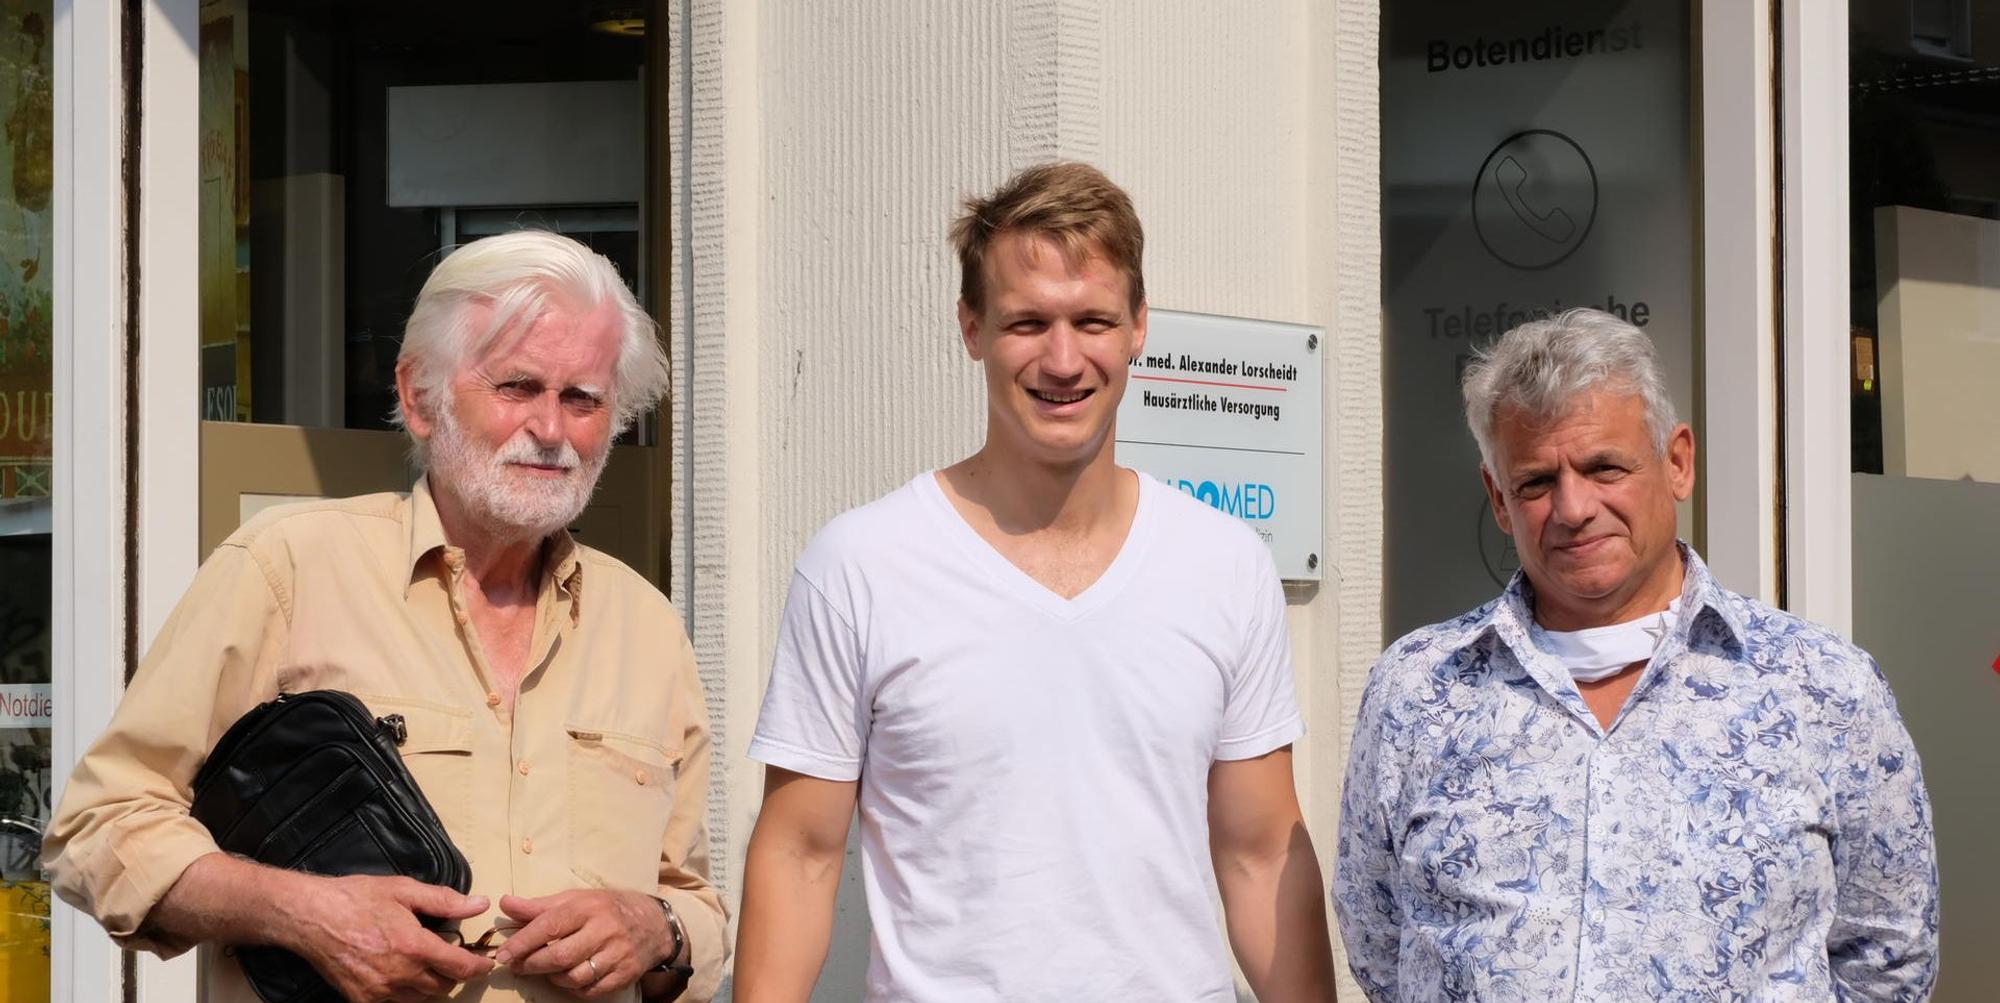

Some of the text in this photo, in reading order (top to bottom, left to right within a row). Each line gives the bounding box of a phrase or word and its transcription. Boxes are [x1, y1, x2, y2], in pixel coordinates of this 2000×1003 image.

[1427, 19, 1643, 72] Botendienst
[1146, 352, 1175, 370] med.
[1179, 355, 1238, 376] Alexander
[1241, 360, 1297, 381] Lorscheidt
[1143, 390, 1280, 421] Hausärztliche Versorgung
[0, 692, 52, 717] Notdie
